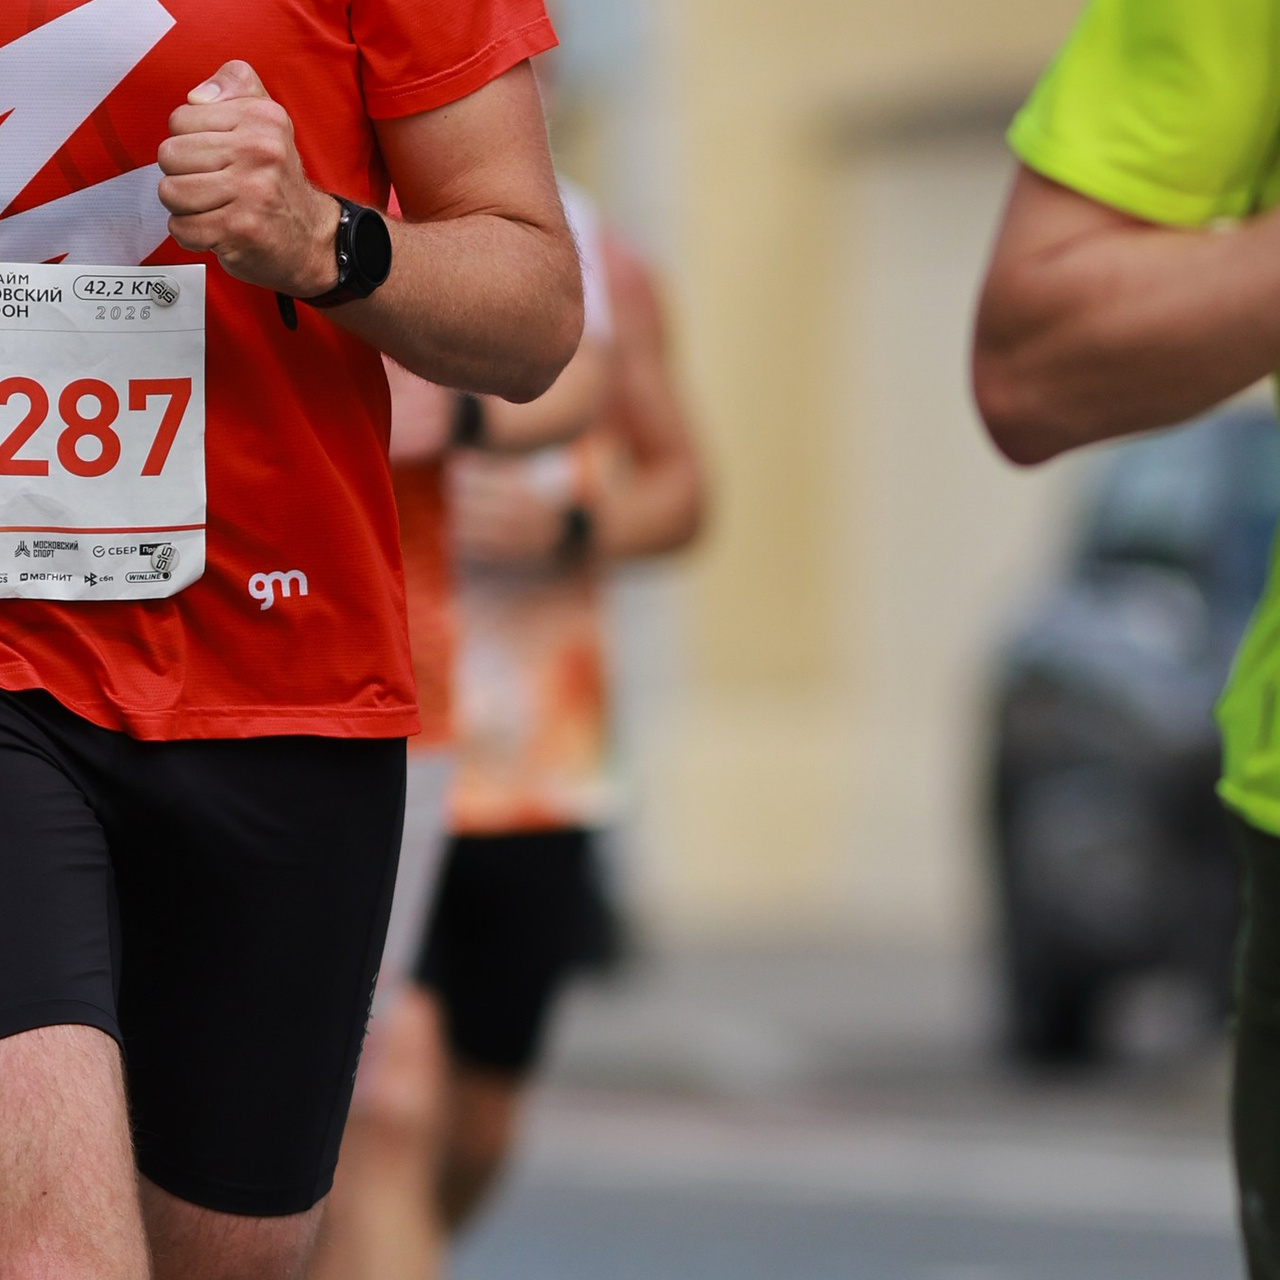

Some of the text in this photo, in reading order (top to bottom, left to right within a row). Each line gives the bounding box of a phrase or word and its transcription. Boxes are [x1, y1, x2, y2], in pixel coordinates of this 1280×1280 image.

[83, 280, 124, 297] 42,2
[95, 306, 151, 320] 2026
[33, 540, 79, 551] МОСКОВСКИЙ
[108, 546, 137, 555] СБЕР
[33, 549, 55, 558] СПОРТ
[248, 569, 308, 610] gm
